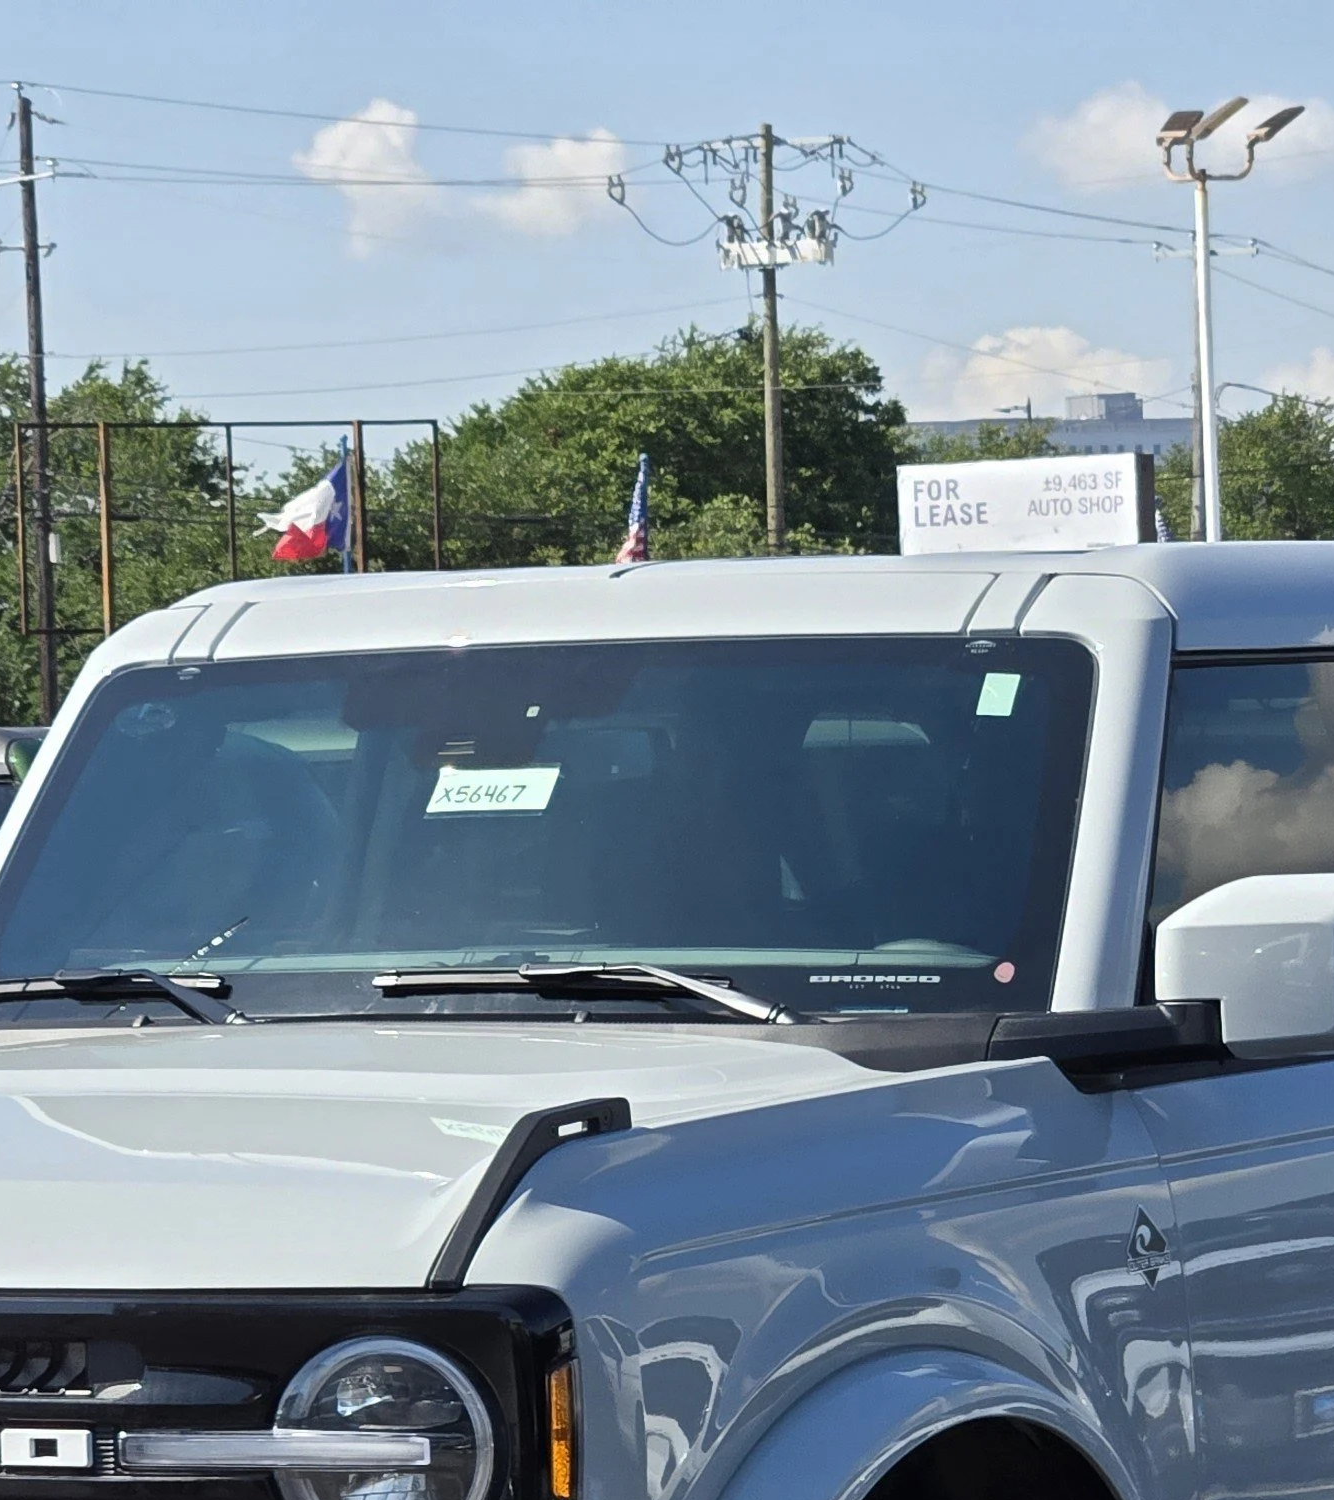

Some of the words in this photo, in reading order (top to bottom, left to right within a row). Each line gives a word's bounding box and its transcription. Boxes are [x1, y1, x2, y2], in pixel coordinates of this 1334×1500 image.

[914, 479, 960, 502] FOR
[1104, 470, 1123, 490] SF
[914, 502, 989, 527] LEASE
[1027, 498, 1072, 517] AUTO
[1078, 495, 1124, 514] SHOP
[435, 785, 527, 804] X56467
